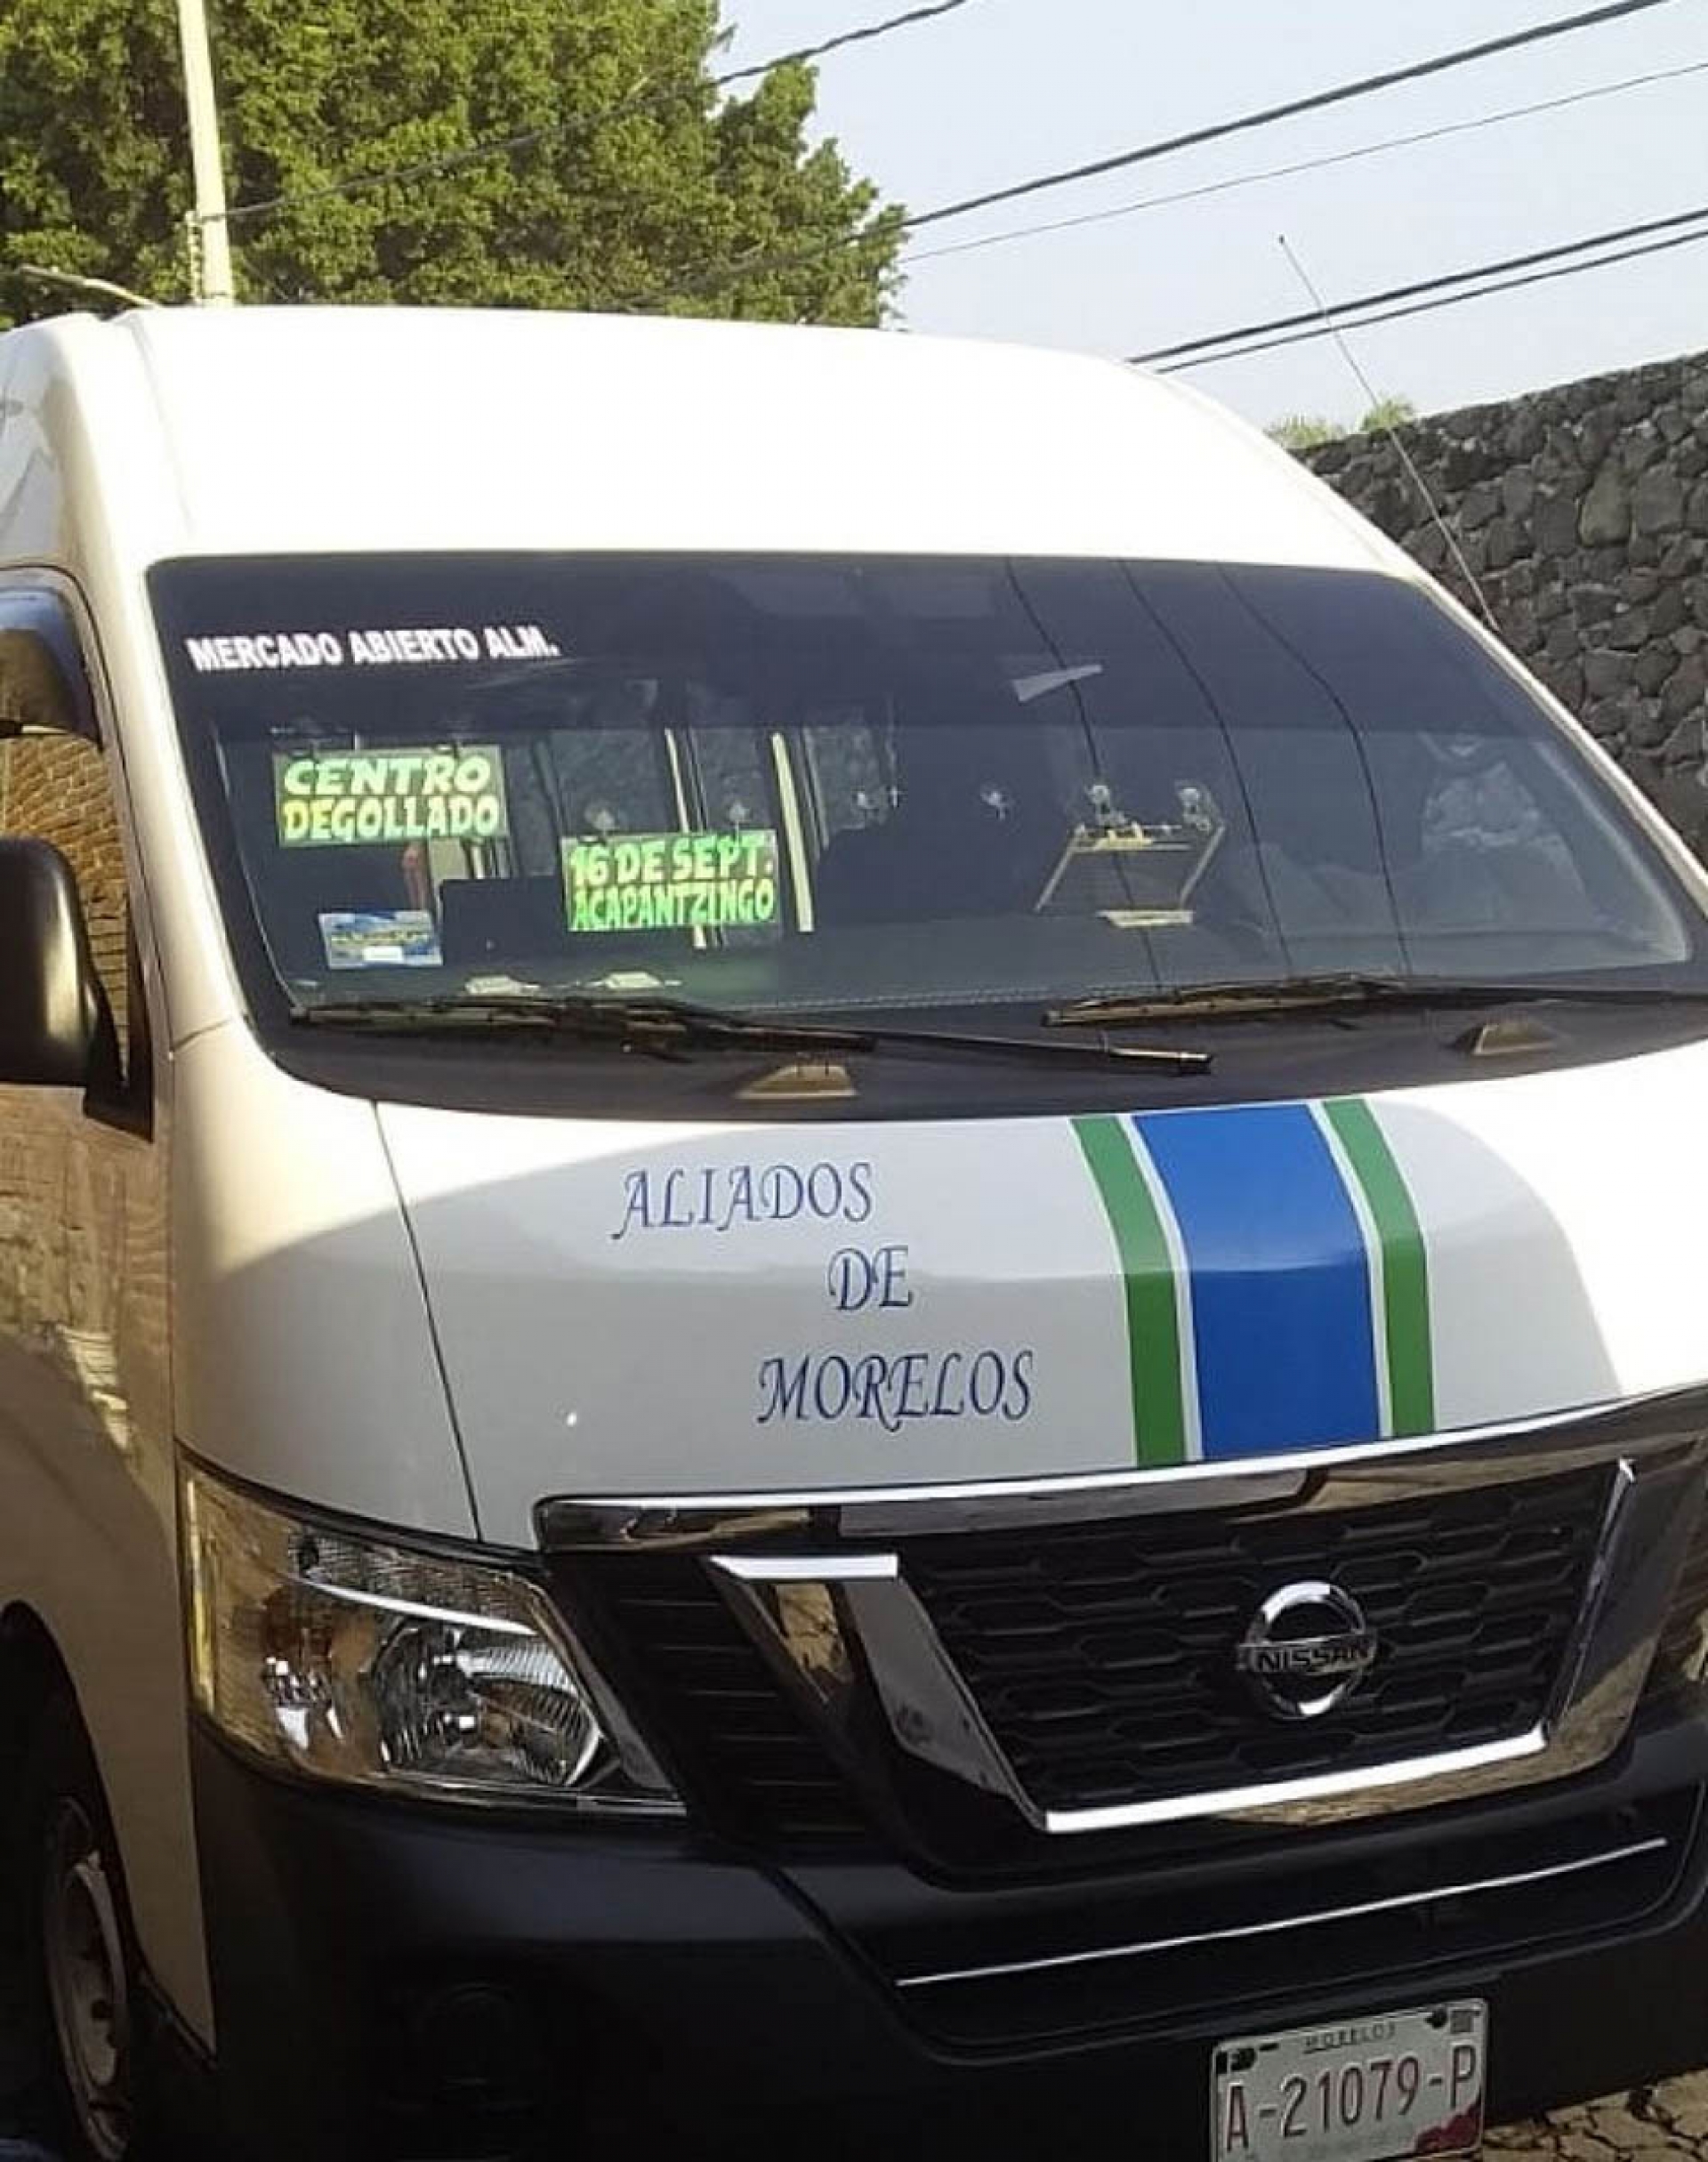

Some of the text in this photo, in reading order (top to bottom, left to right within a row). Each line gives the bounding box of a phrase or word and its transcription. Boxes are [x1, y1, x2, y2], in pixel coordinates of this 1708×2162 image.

[185, 625, 561, 672] MERCADO ABIERTO ALM.
[284, 755, 490, 795] CENTRO
[282, 795, 499, 841] DEGOLLADO
[570, 833, 774, 886] 16 DE SEPT.
[574, 877, 775, 929] ACAPANTZINGO
[610, 1161, 874, 1240] ALIADOS
[827, 1245, 914, 1311] DE
[756, 1350, 1035, 1432] MORELOS
[1255, 1642, 1371, 1672] NISSAN
[1226, 2044, 1478, 2152] A-21079-P
